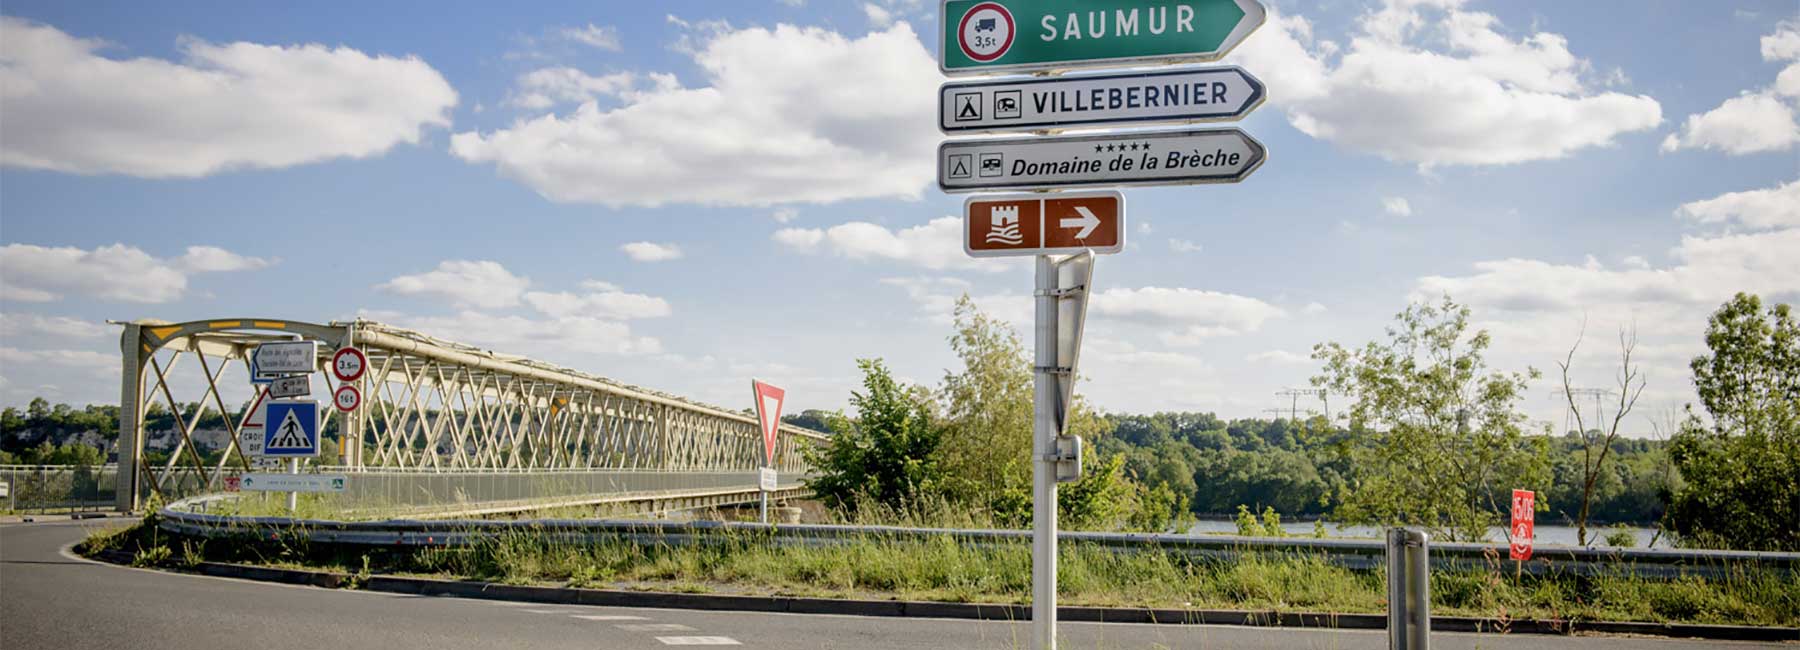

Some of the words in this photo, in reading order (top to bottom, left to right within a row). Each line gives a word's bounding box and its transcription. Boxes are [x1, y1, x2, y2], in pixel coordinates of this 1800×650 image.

[1040, 4, 1195, 42] SAUMUR
[1032, 82, 1228, 114] VILLEBERNIER
[1011, 156, 1102, 176] Domaine
[1109, 154, 1134, 172] de
[1140, 153, 1158, 170] la
[1165, 149, 1240, 169] Brèche
